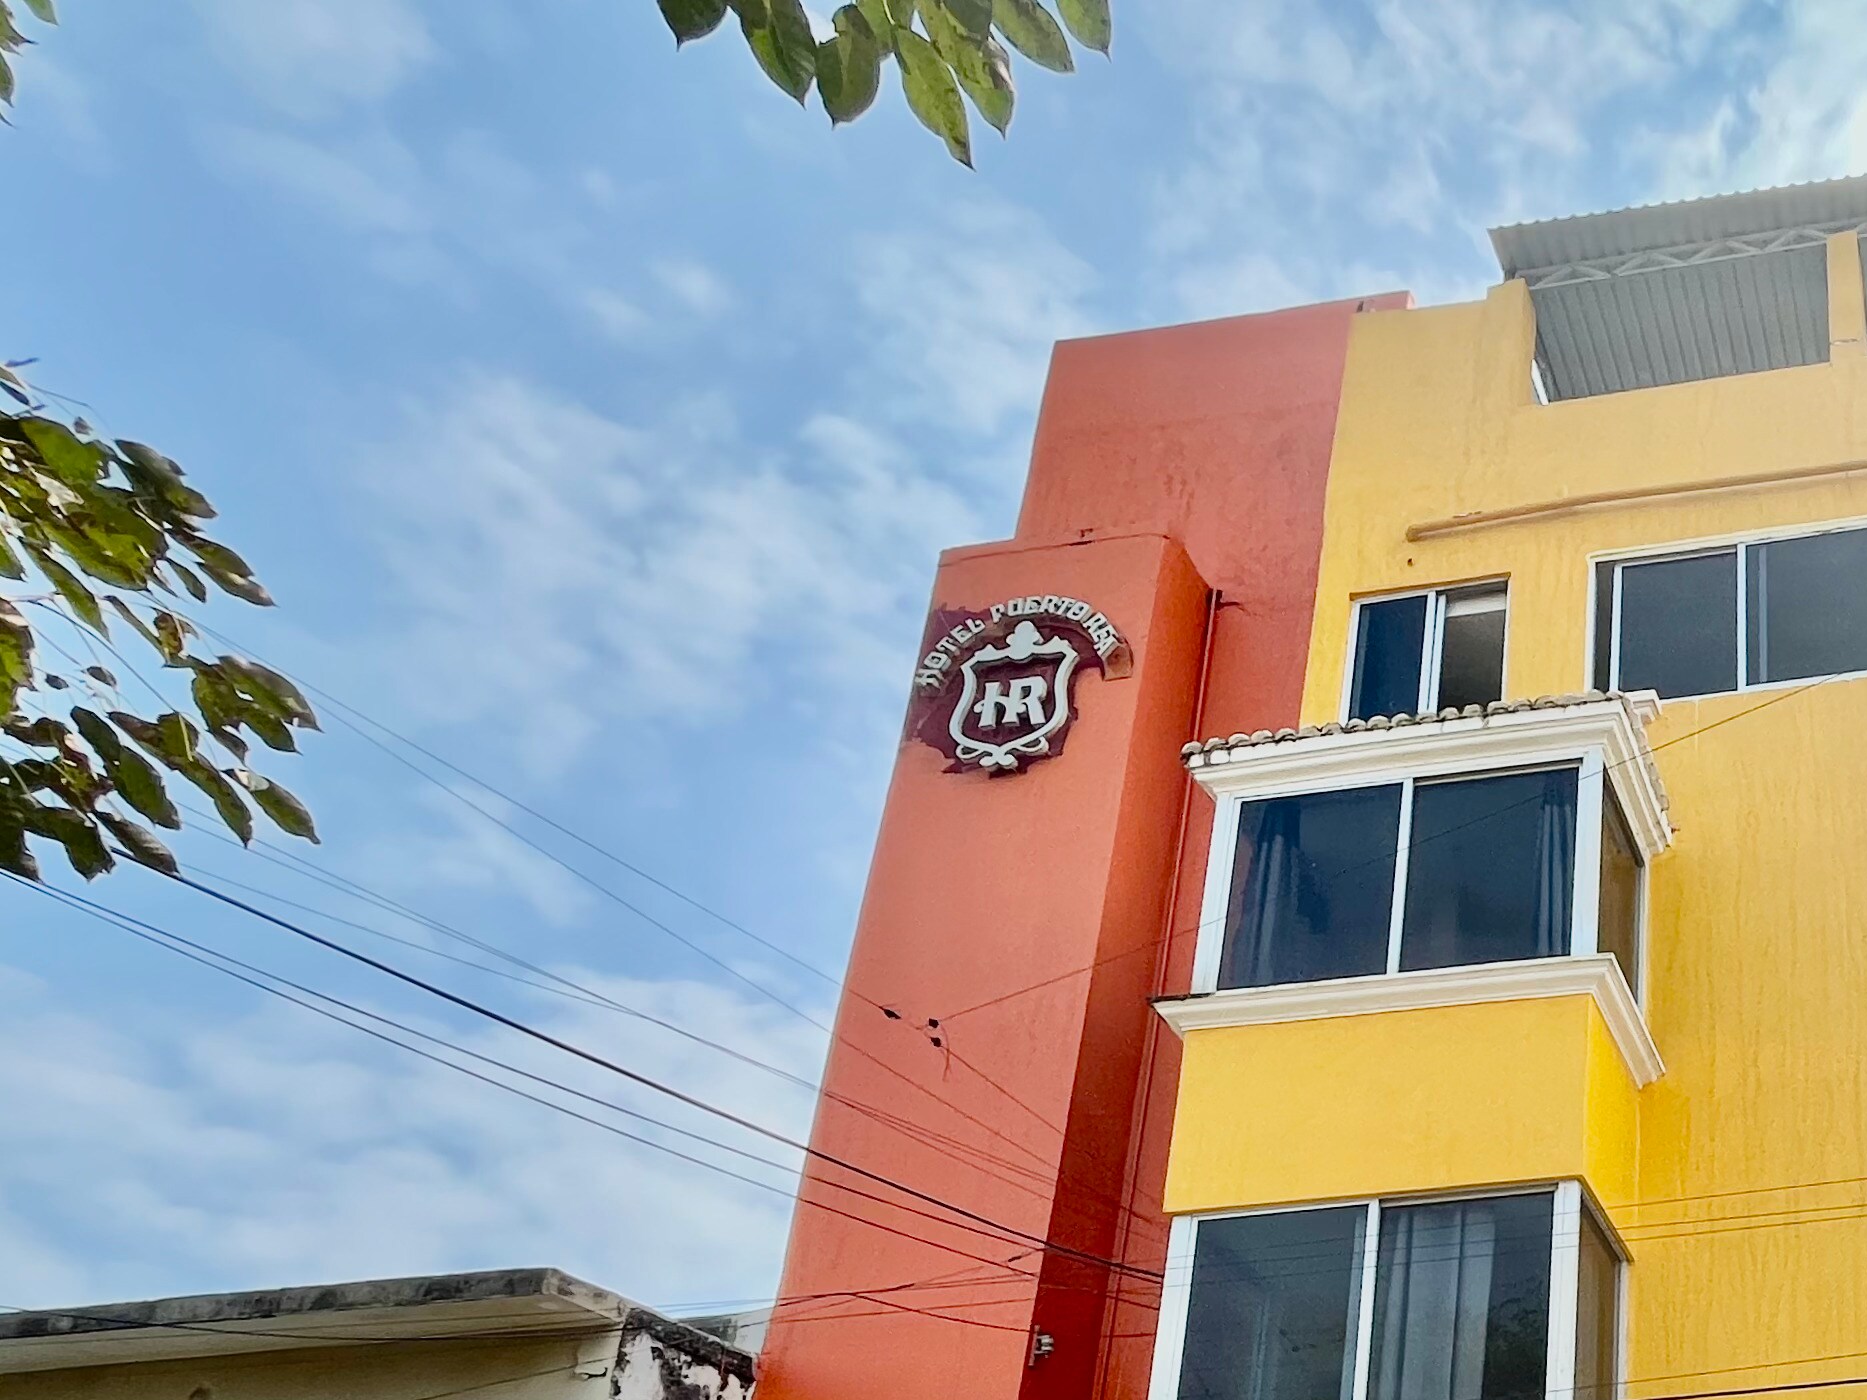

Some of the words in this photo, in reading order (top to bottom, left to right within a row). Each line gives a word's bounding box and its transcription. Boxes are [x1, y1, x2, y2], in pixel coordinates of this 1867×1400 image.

[915, 618, 985, 690] HOTEL
[989, 596, 1092, 624] PUERTO
[973, 675, 1048, 730] HR
